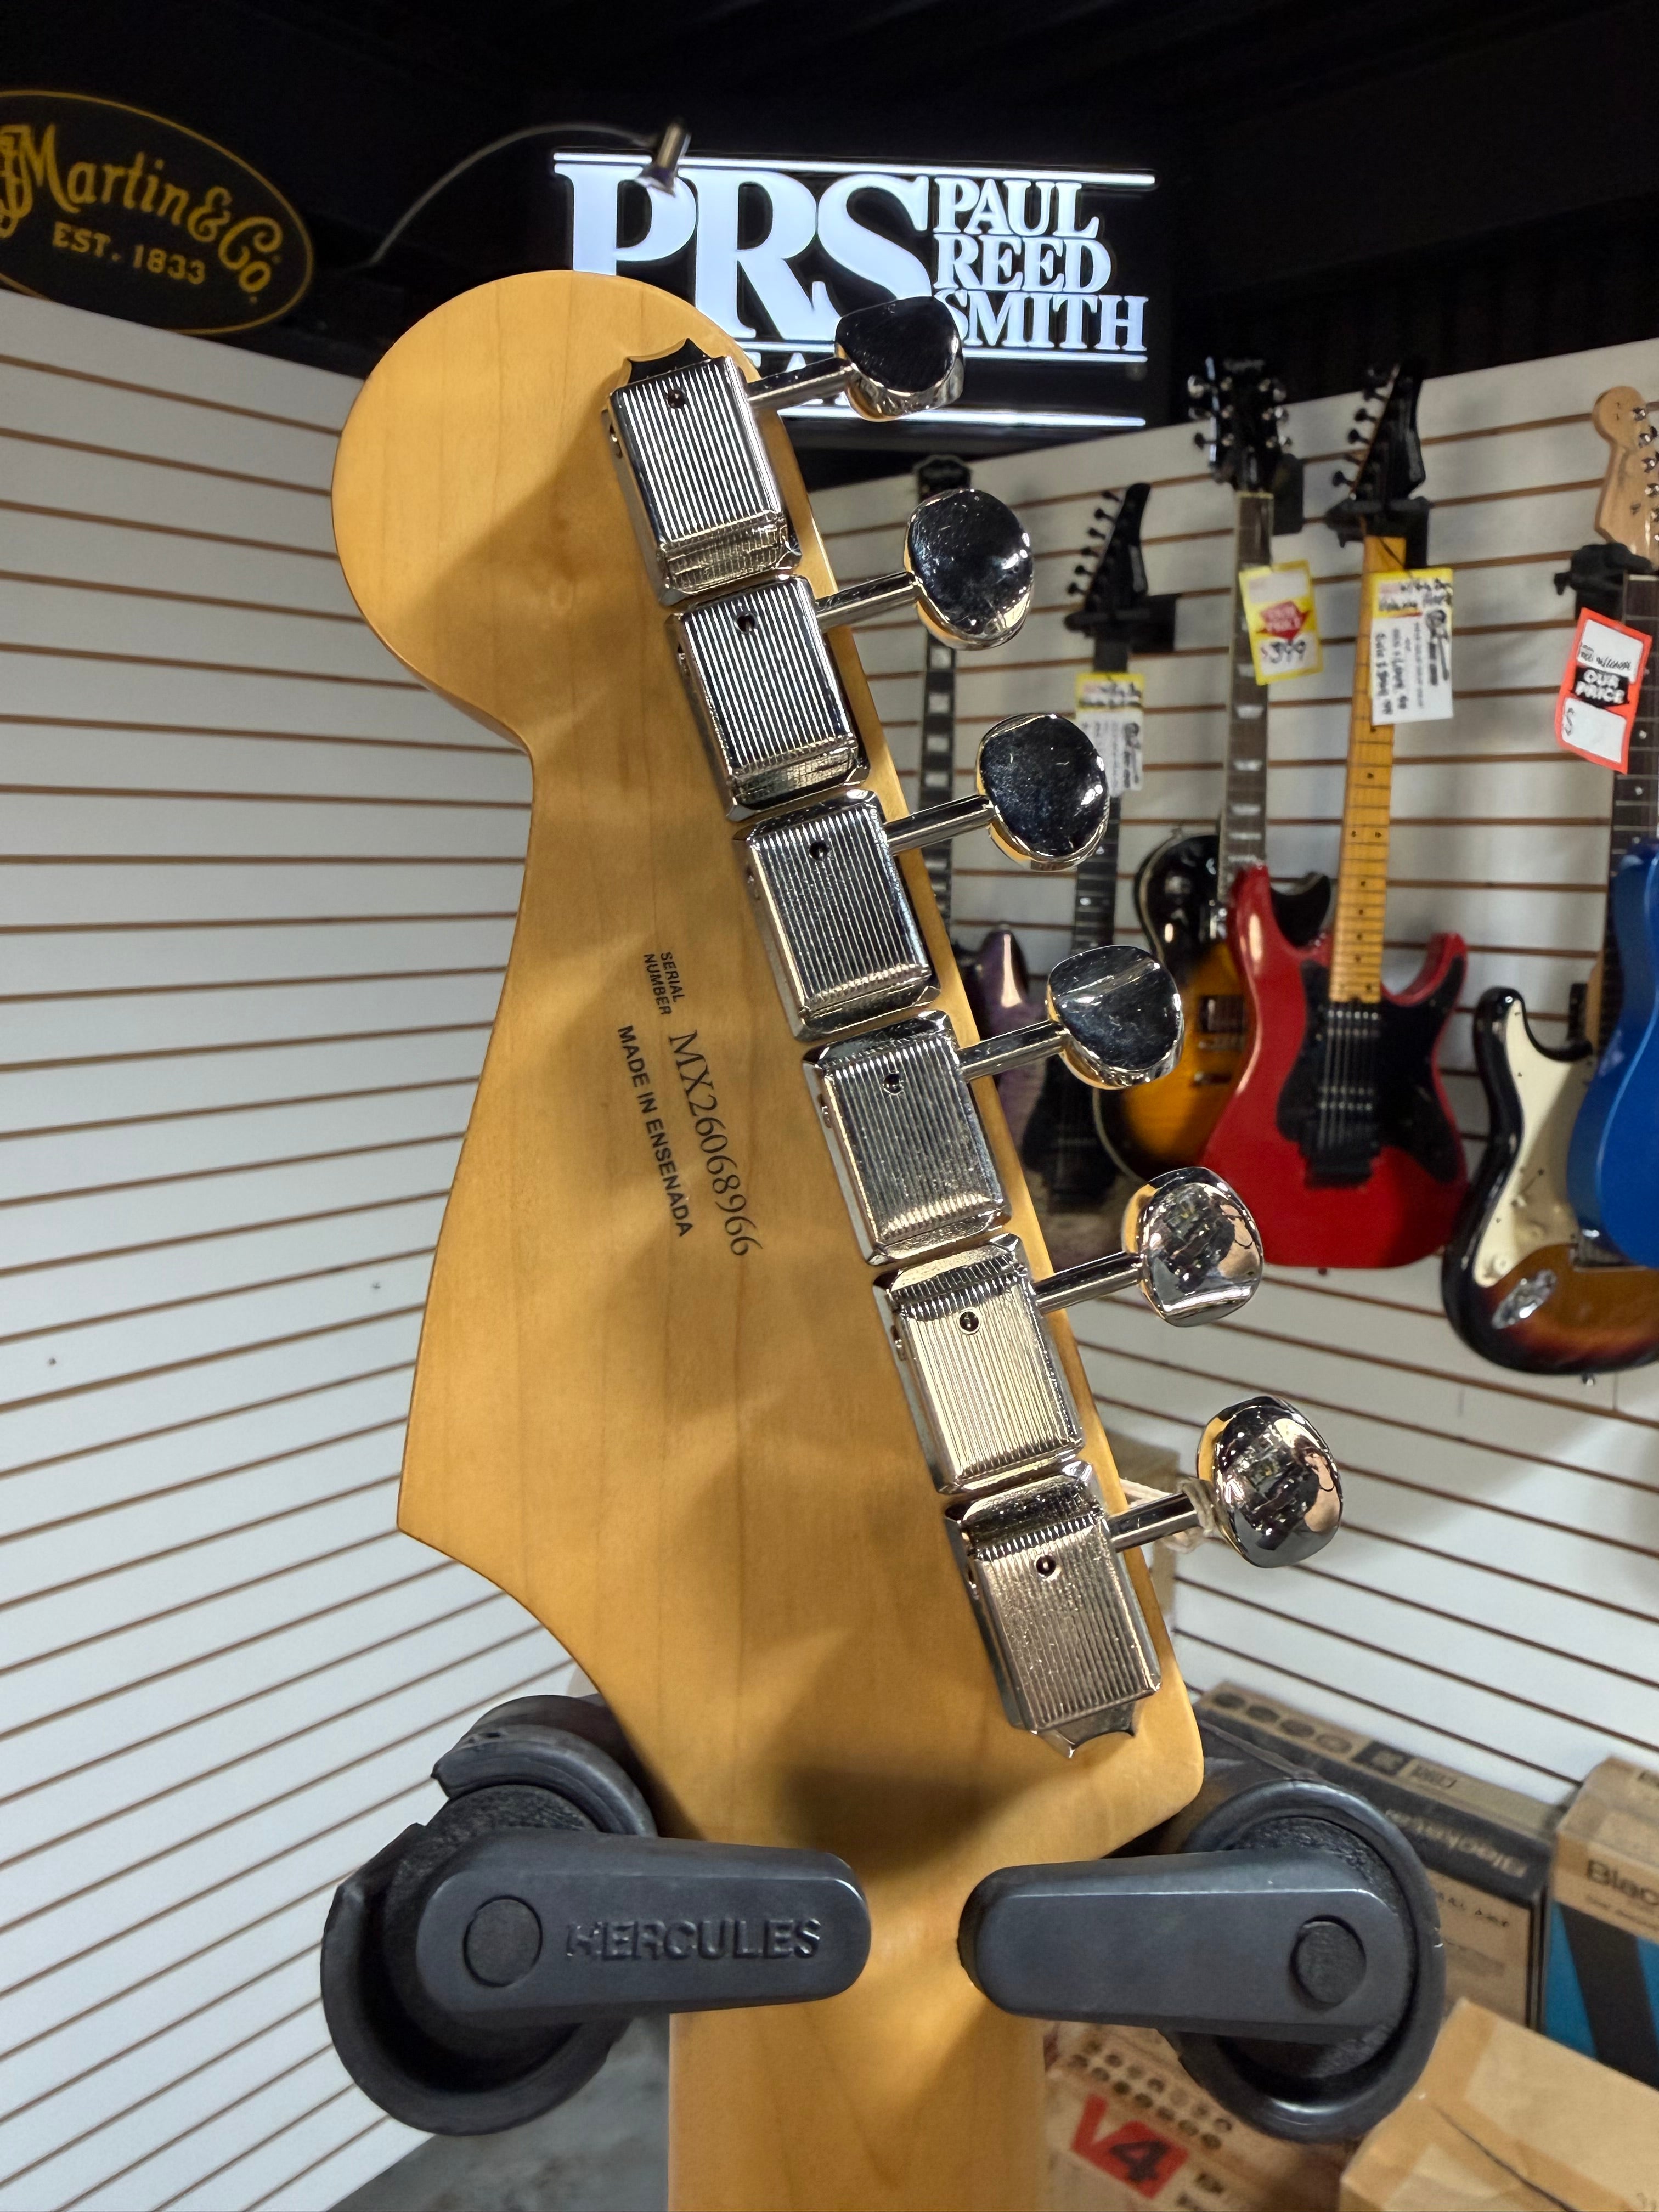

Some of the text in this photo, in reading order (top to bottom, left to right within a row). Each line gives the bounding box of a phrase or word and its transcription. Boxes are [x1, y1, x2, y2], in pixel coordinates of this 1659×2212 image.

[933, 177, 1100, 239] PAUL
[53, 221, 205, 284] EST. 1833
[554, 162, 932, 342] PRS
[933, 233, 1112, 294] REED
[934, 289, 1149, 352] SMITH
[643, 953, 673, 1015] NUMBER
[660, 951, 685, 1003] SERIAL
[617, 1025, 693, 1238] MADE IN ENSENADA
[668, 1029, 764, 1256] MX26068966
[566, 1918, 822, 1961] HERCULES
